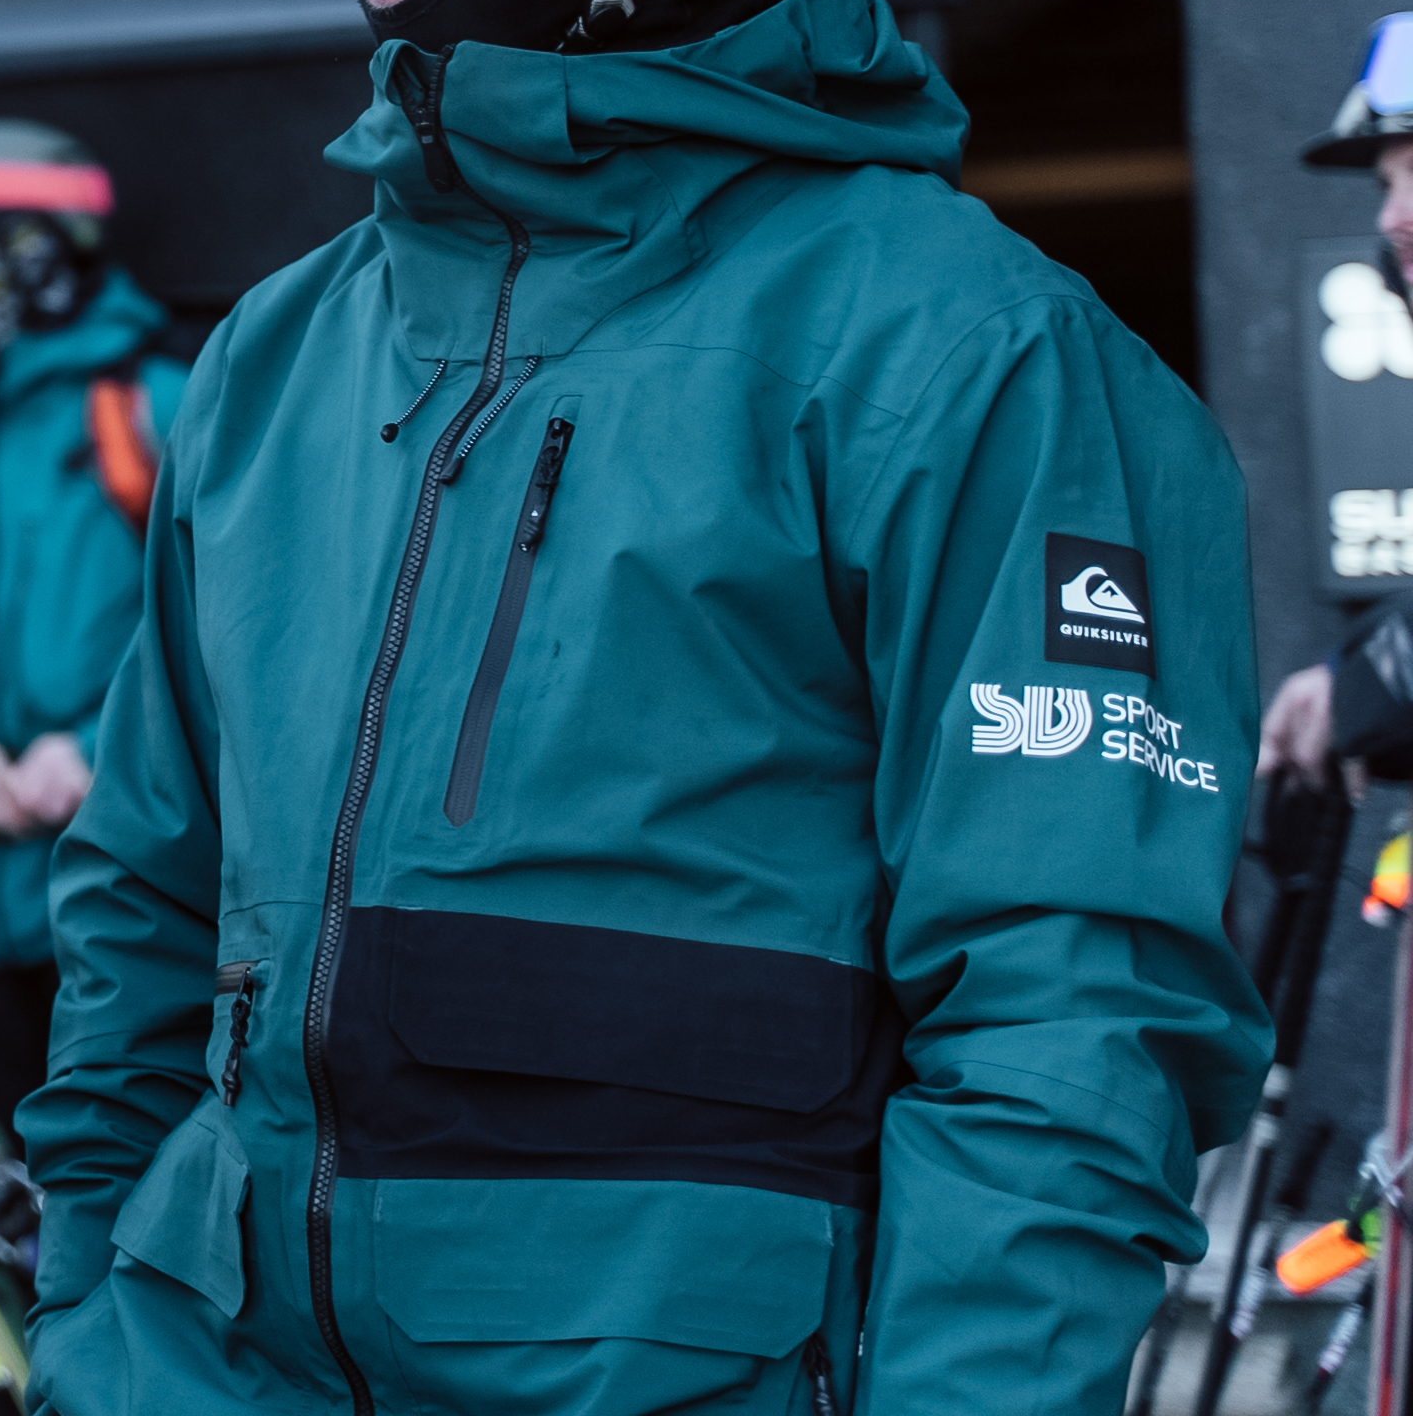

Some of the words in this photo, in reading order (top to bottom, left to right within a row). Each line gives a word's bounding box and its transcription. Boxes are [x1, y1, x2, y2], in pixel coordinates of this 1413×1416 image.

[1059, 623, 1149, 648] QUIKSILVER
[1102, 692, 1183, 750] SPORT
[1101, 730, 1220, 793] SERVICE
